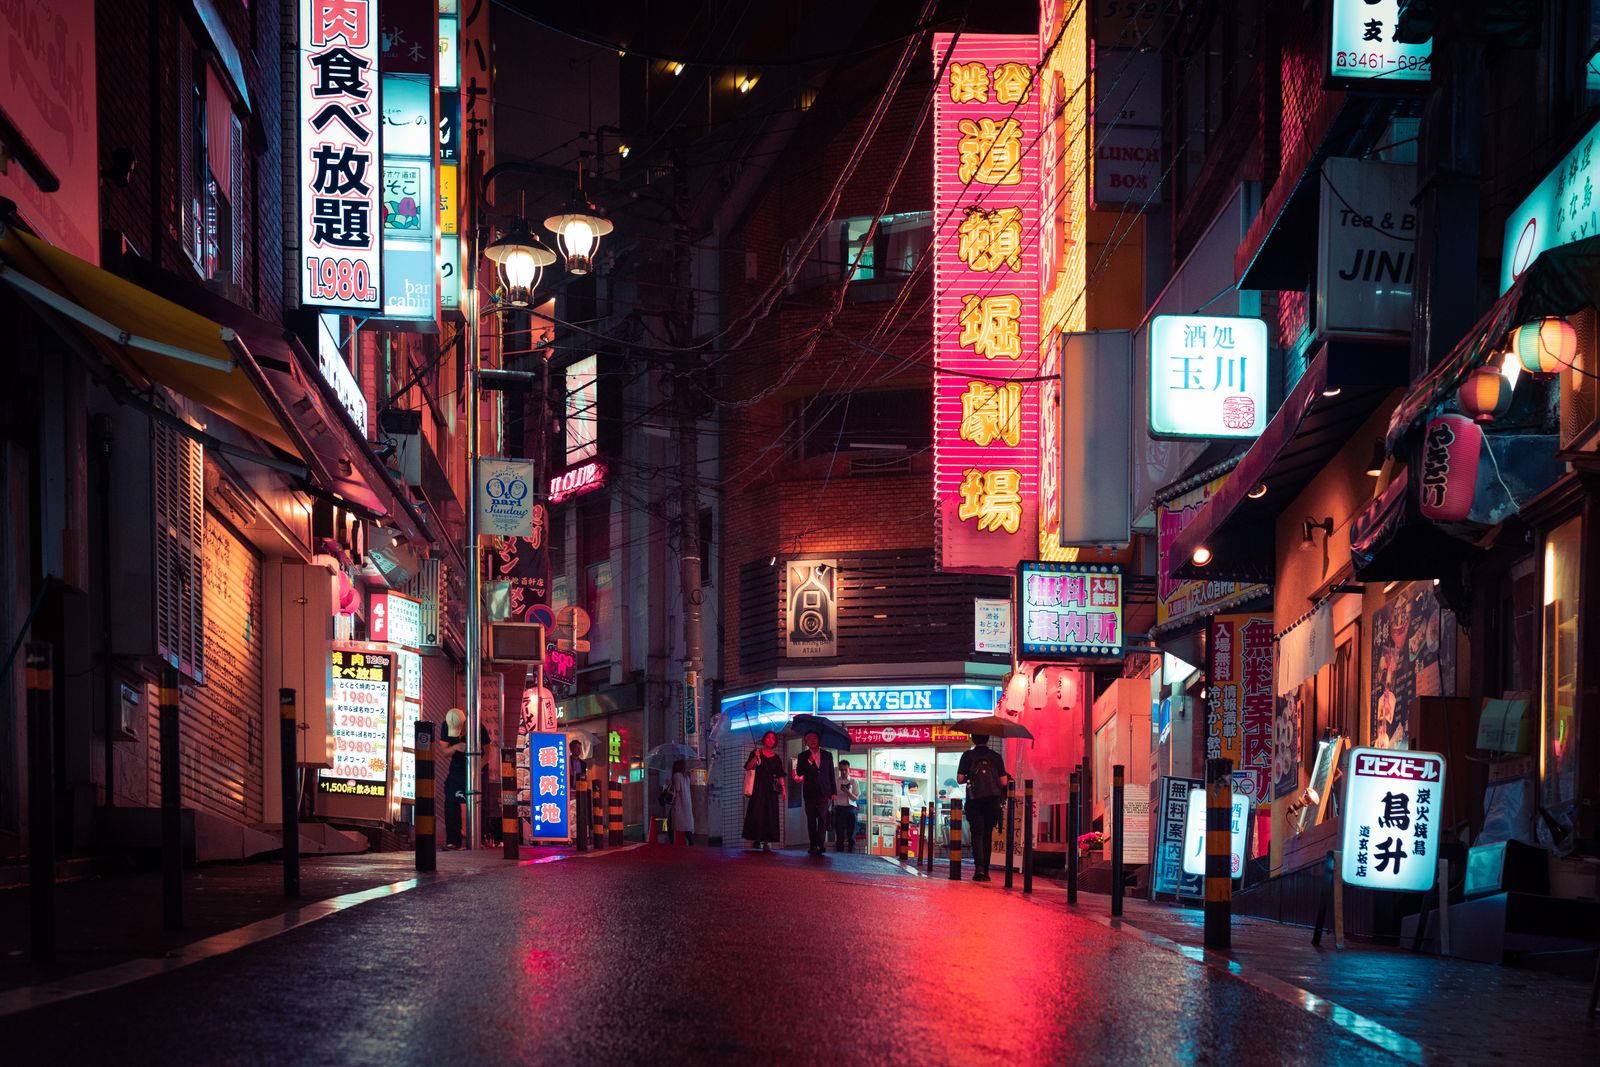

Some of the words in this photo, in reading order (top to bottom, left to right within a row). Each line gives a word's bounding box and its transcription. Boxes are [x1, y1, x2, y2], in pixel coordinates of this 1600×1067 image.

[950, 62, 1033, 104] 渋谷
[309, 0, 374, 250] 肉食べ放題
[1100, 146, 1160, 162] LUNCH
[1109, 174, 1149, 188] BOX
[1340, 209, 1374, 228] Tea
[1381, 212, 1395, 229] &
[307, 256, 376, 302] 1,980円
[404, 279, 431, 294] bar
[958, 117, 1024, 534] 道頓堀劇場
[1184, 324, 1236, 349] 酒処
[1169, 356, 1248, 393] 玉川
[485, 504, 529, 519] Sunday
[1028, 574, 1088, 607] 無料
[1028, 610, 1118, 644] 案内所
[1214, 623, 1231, 681] 入場無料
[832, 691, 932, 710] LAWSON
[538, 746, 561, 823] 番外地
[1374, 791, 1411, 875] 鳥升
[1412, 788, 1431, 857] 炭火焼鳥
[1356, 825, 1371, 877] 道玄坂店
